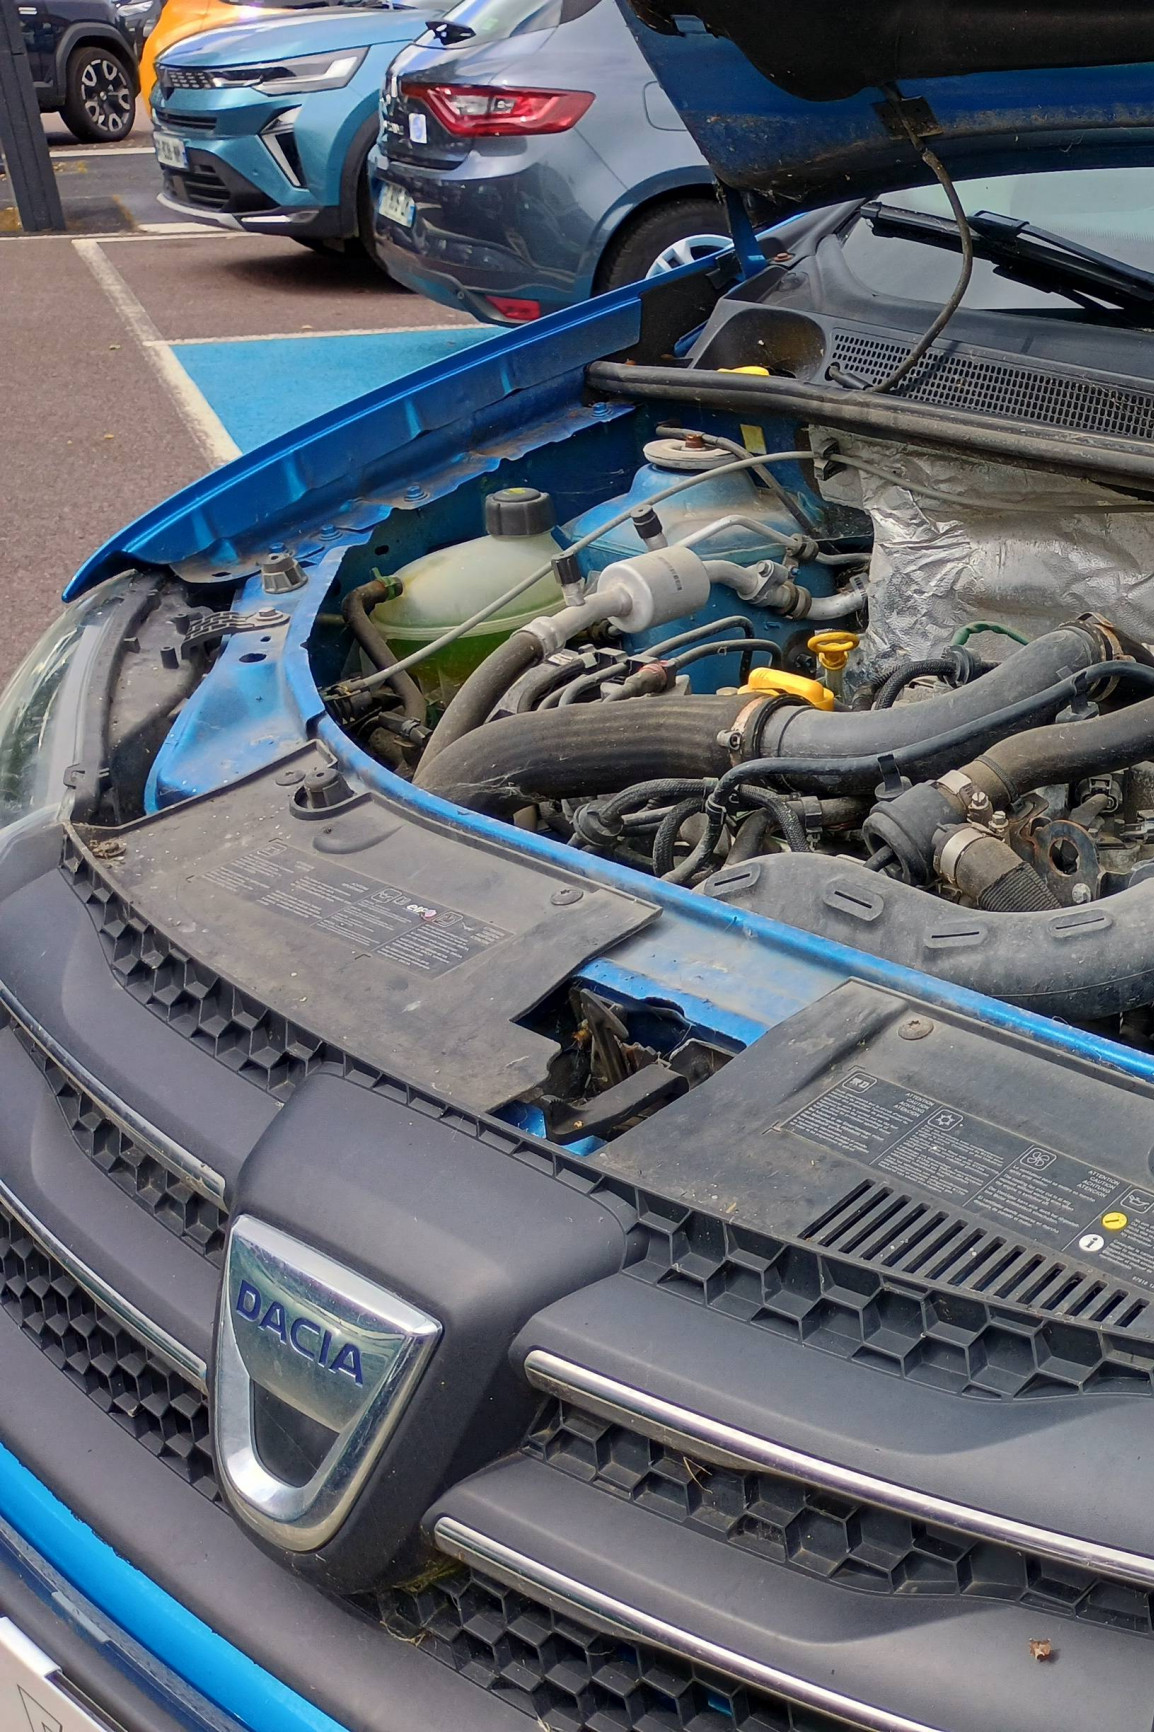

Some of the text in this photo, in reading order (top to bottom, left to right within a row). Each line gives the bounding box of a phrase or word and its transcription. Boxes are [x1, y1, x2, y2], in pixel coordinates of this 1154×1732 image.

[905, 1093, 935, 1106] ATTENTION
[906, 1098, 930, 1110] CAUTION
[899, 1101, 925, 1113] ACHTUNG
[1088, 1170, 1120, 1185] ATTENTION
[1089, 1177, 1116, 1189] CAUTION
[1082, 1180, 1111, 1193] ACHTUNG
[236, 1280, 364, 1388] DACIA
